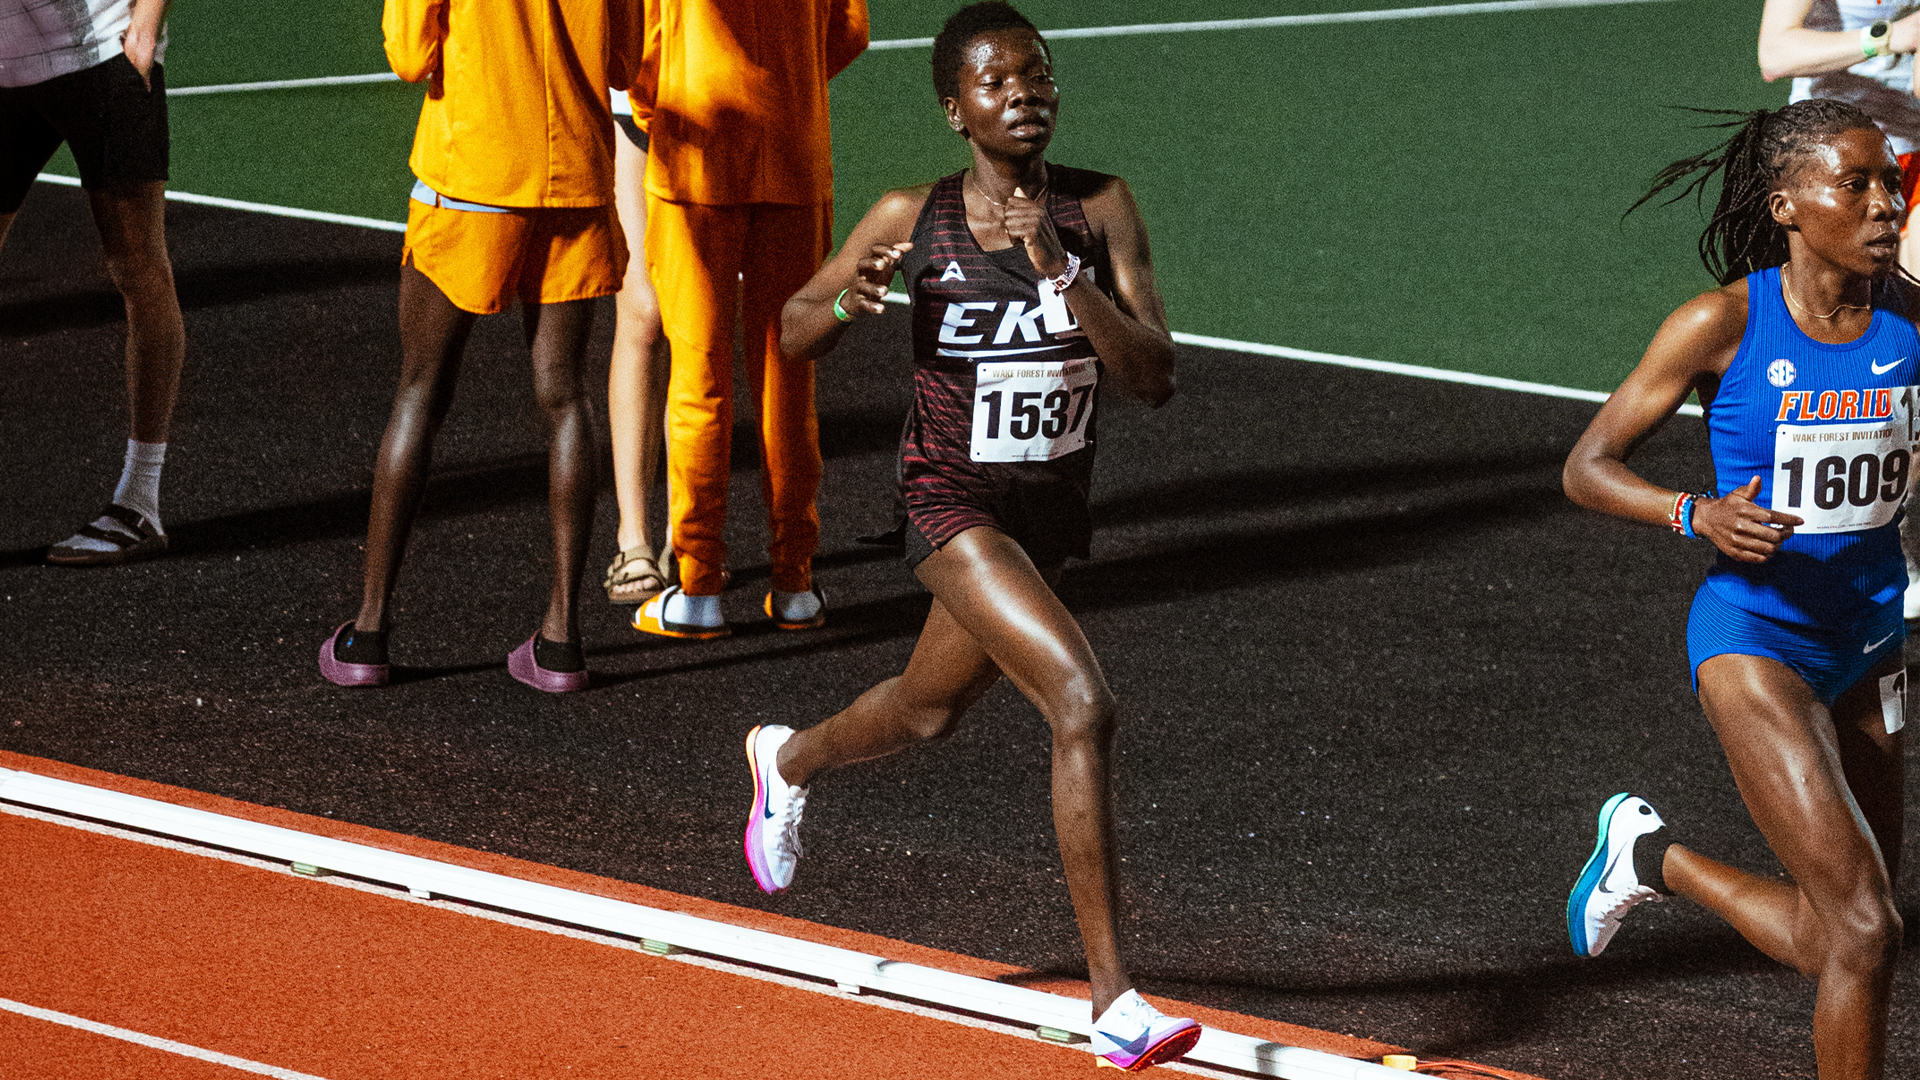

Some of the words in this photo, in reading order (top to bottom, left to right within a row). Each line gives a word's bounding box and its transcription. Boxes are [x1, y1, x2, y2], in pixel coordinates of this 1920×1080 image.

[992, 369, 1014, 378] WAKE
[1016, 369, 1045, 378] FOREST
[1769, 361, 1795, 384] SEC
[981, 383, 1095, 440] 1537
[1775, 388, 1894, 421] FLORID
[1792, 433, 1817, 443] WAKE
[1819, 431, 1850, 442] FOREST
[1781, 449, 1911, 510] 1609
